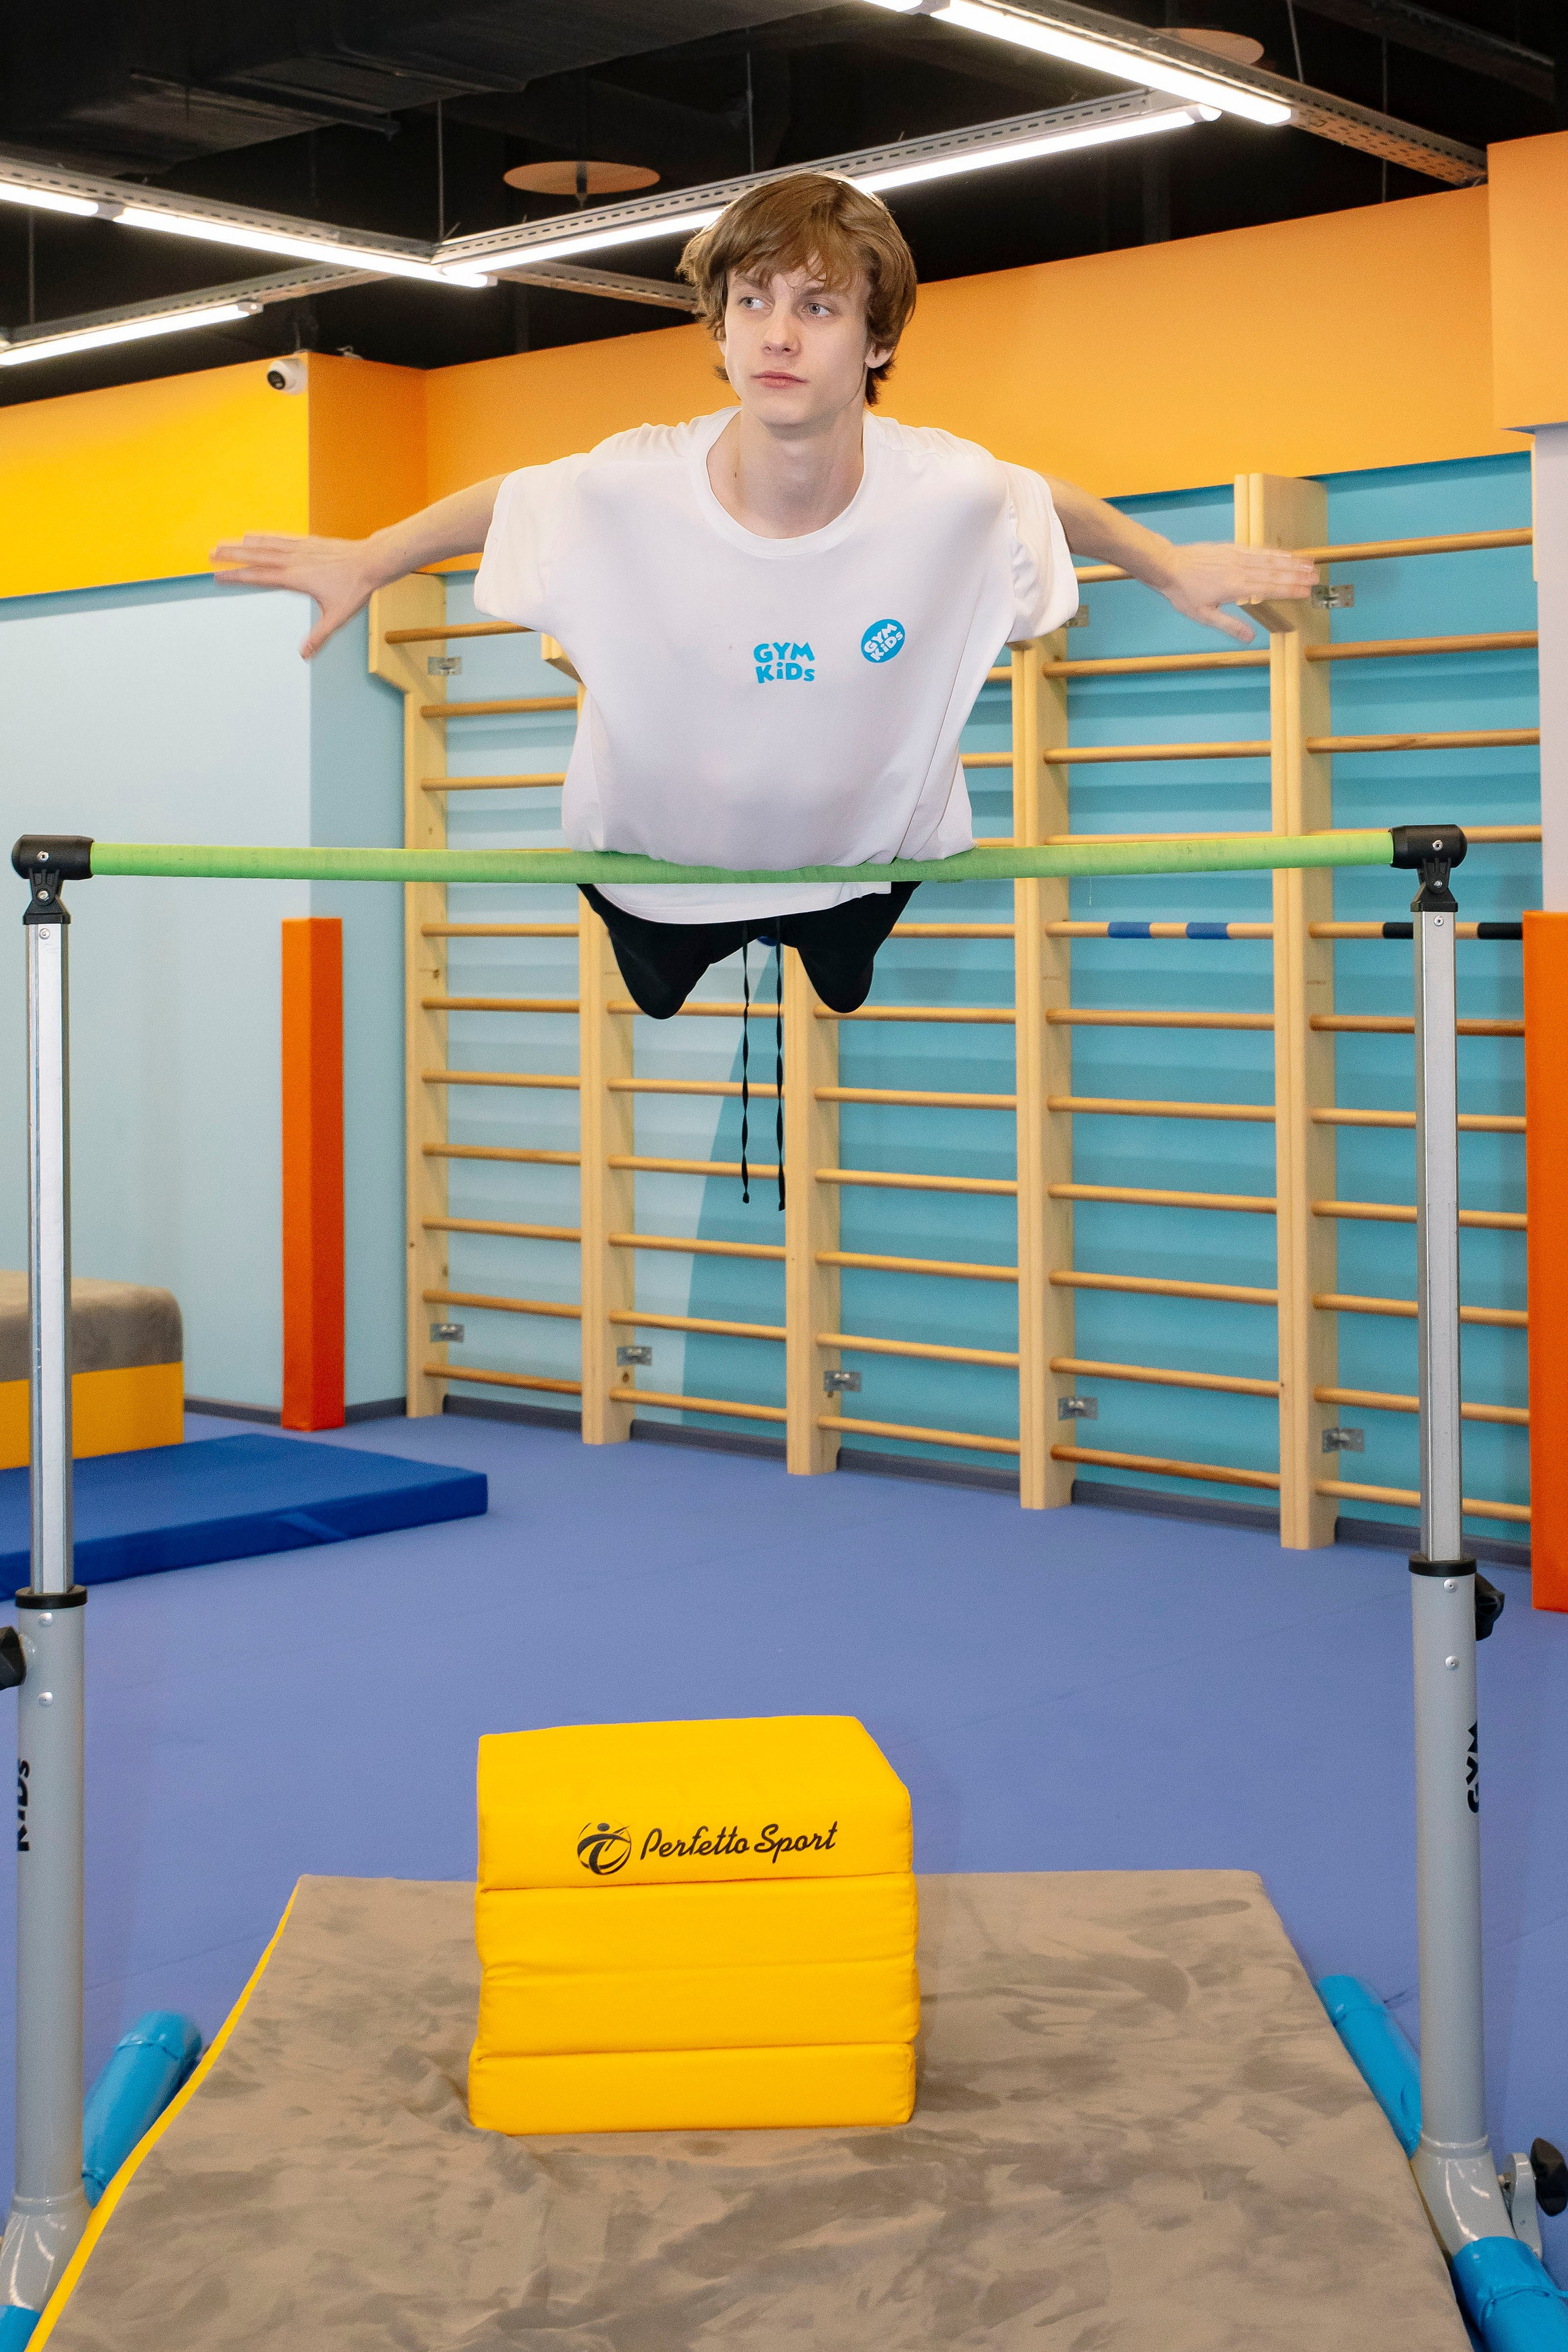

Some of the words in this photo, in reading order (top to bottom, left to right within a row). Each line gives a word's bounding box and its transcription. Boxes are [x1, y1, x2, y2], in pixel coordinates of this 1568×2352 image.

[753, 641, 815, 663] GYM
[864, 623, 898, 654] GYM
[639, 1825, 750, 1861] Perfetto
[753, 1820, 839, 1864] Sport
